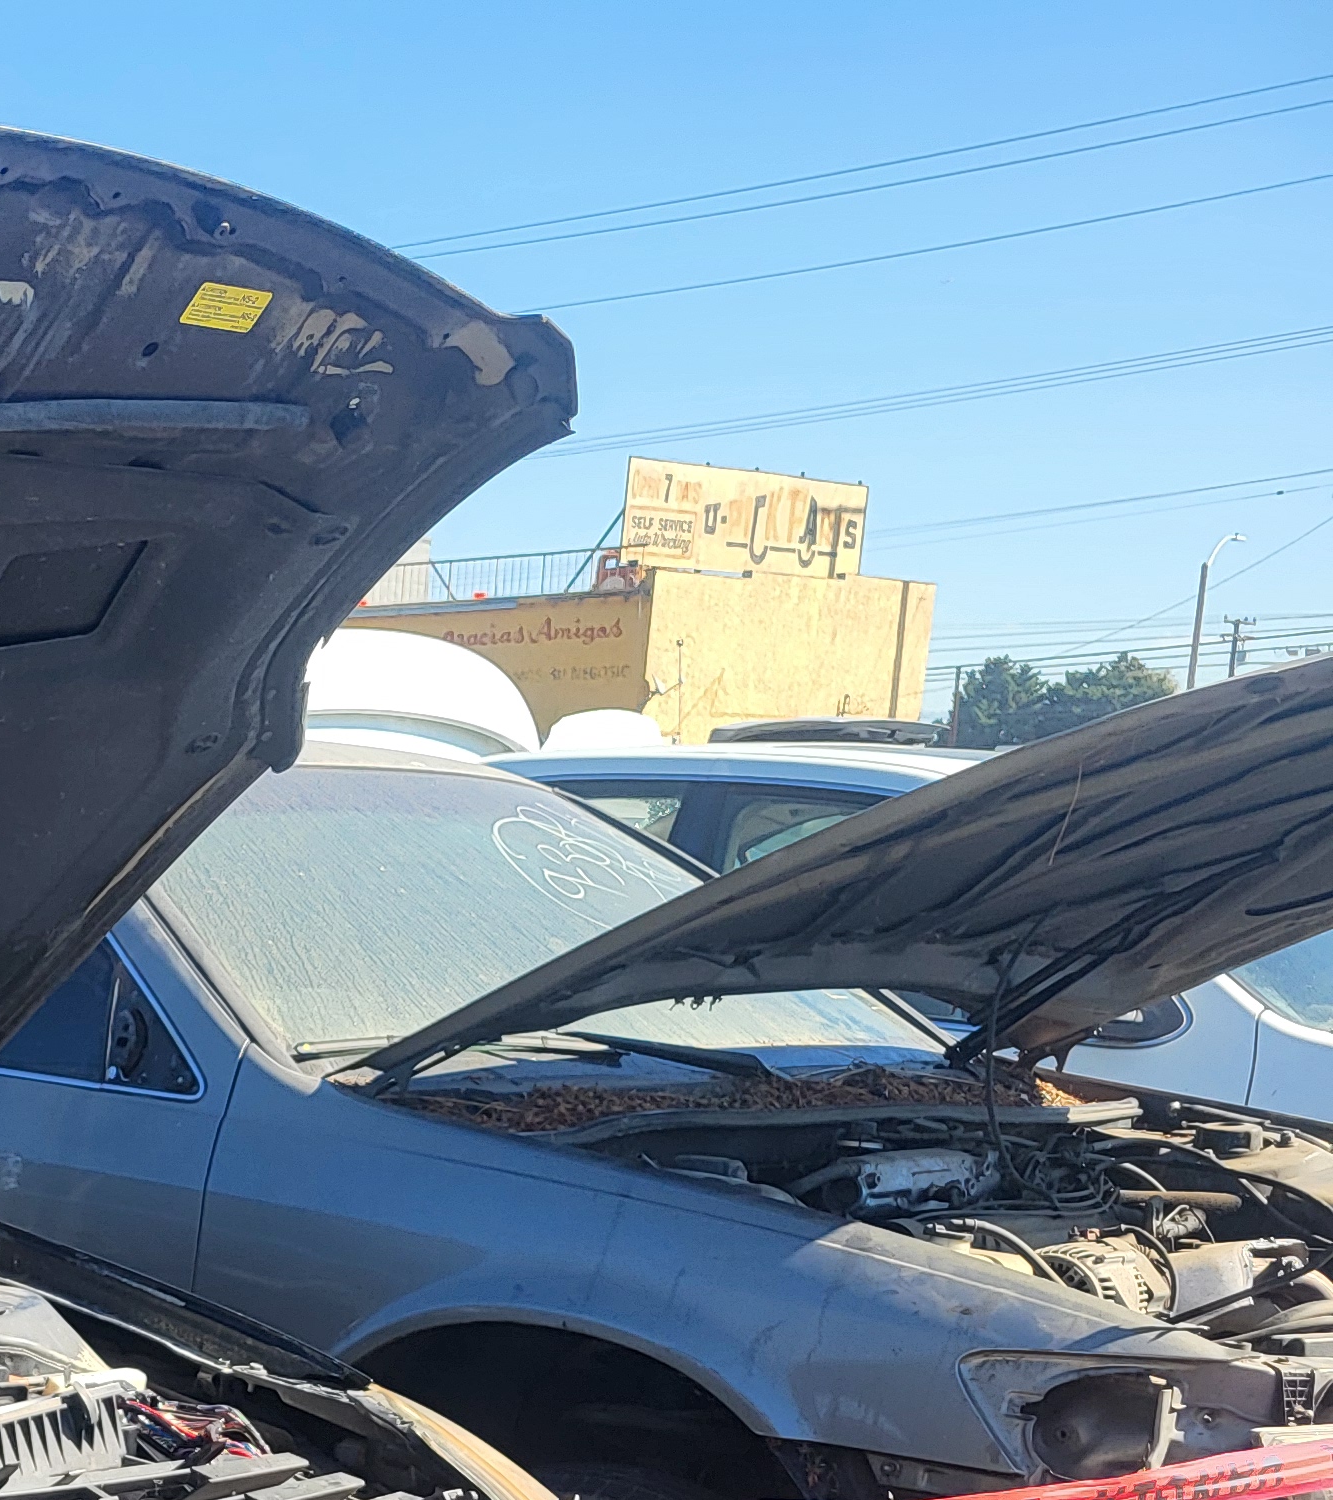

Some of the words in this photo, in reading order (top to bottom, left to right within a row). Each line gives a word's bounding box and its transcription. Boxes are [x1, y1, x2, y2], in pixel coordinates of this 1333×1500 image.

[664, 473, 674, 504] 7
[631, 515, 654, 530] SELF
[658, 517, 693, 533] SERVICE
